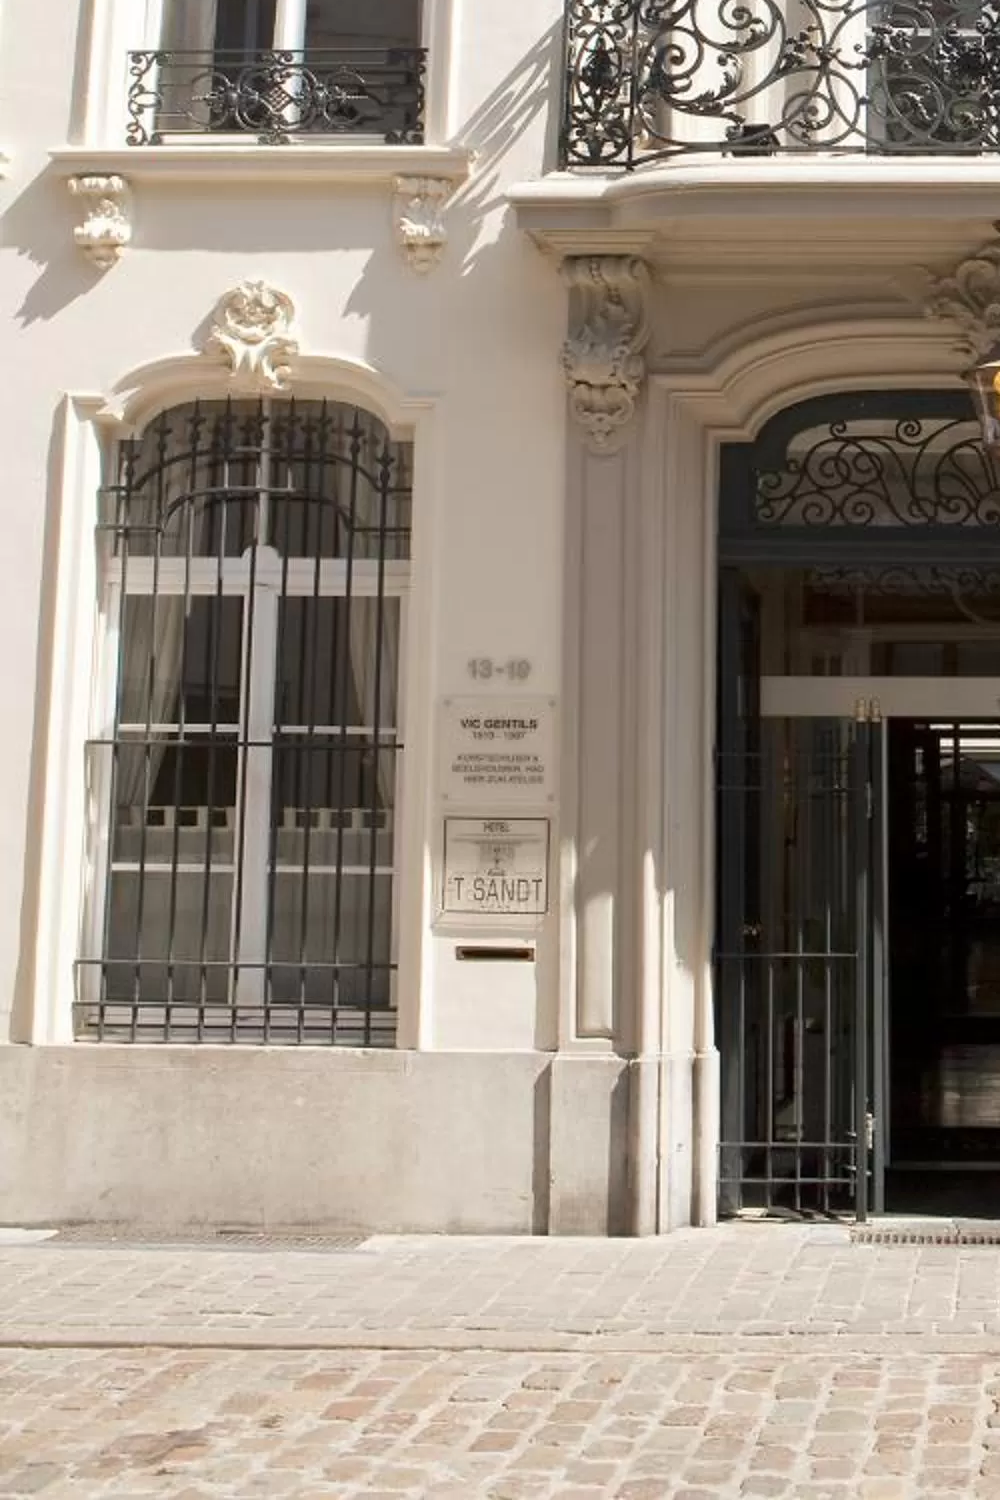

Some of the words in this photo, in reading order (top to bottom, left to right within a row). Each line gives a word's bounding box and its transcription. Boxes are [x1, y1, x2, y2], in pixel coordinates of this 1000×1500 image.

[460, 718, 481, 730] VIC
[483, 718, 538, 730] GENTILS
[473, 877, 543, 902] SANDT
